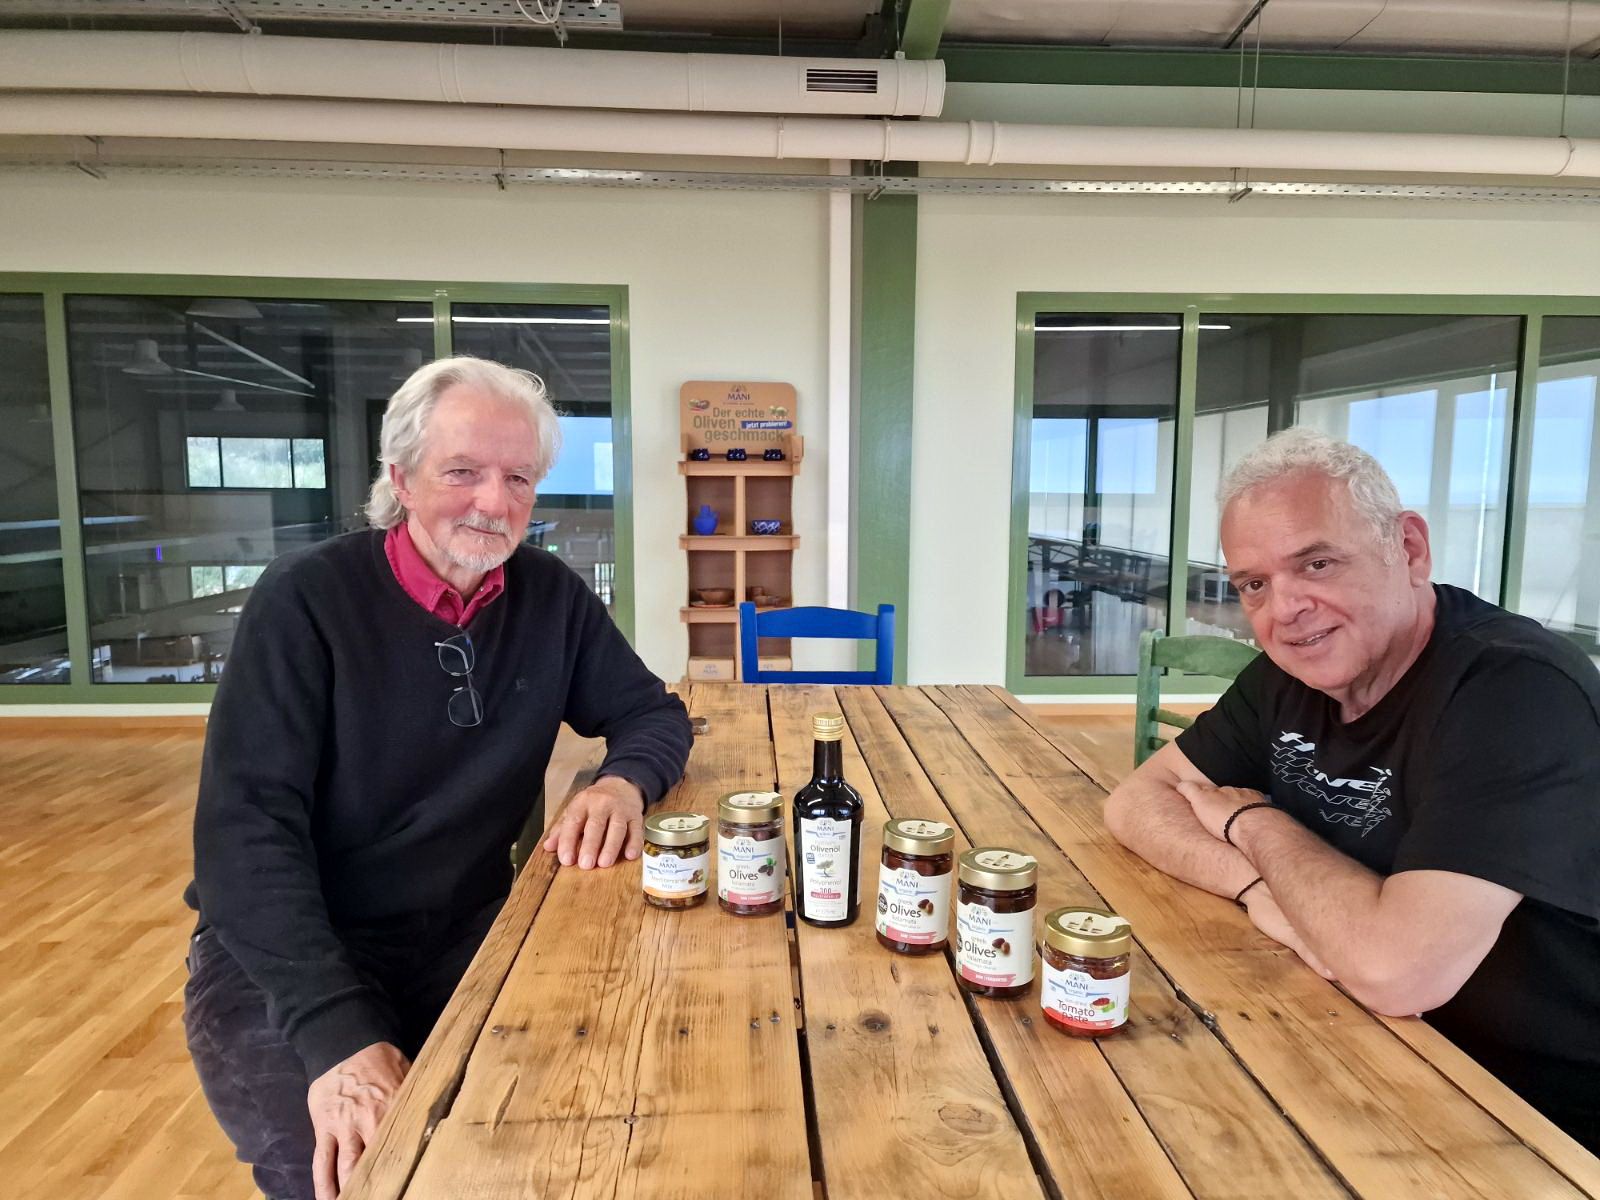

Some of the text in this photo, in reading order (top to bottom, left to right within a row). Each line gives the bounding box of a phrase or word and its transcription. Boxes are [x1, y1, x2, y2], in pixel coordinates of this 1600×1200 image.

[712, 407, 765, 418] Der echte
[693, 414, 736, 430] Oliven
[704, 428, 785, 444] geschmack
[816, 825, 834, 833] MANI
[733, 845, 755, 853] MANI
[729, 869, 759, 881] Olives
[895, 878, 919, 888] MANI
[889, 903, 922, 918] Olives
[968, 914, 991, 926] MANI
[964, 940, 997, 958] Olives
[1064, 979, 1089, 991] MANI
[1057, 998, 1096, 1017] Tomato
